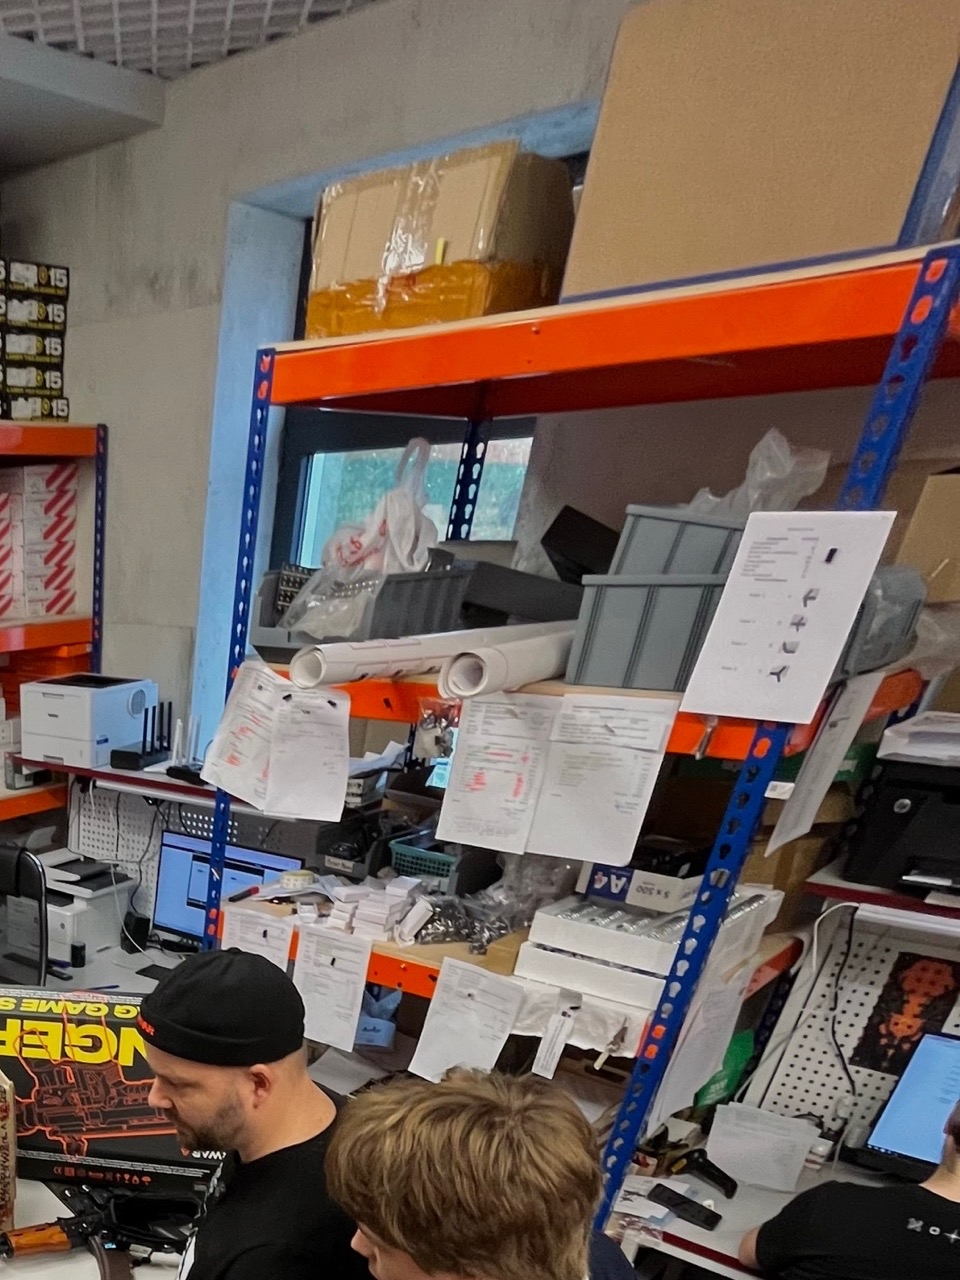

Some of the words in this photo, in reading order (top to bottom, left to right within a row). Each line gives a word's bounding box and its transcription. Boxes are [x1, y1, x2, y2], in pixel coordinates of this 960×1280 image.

[49, 268, 68, 288] 15
[46, 303, 65, 323] 15
[44, 337, 62, 356] 15
[44, 370, 62, 389] 15
[51, 399, 69, 417] 15
[594, 871, 627, 893] A4
[636, 885, 655, 896] 500
[21, 998, 110, 1017] GAME
